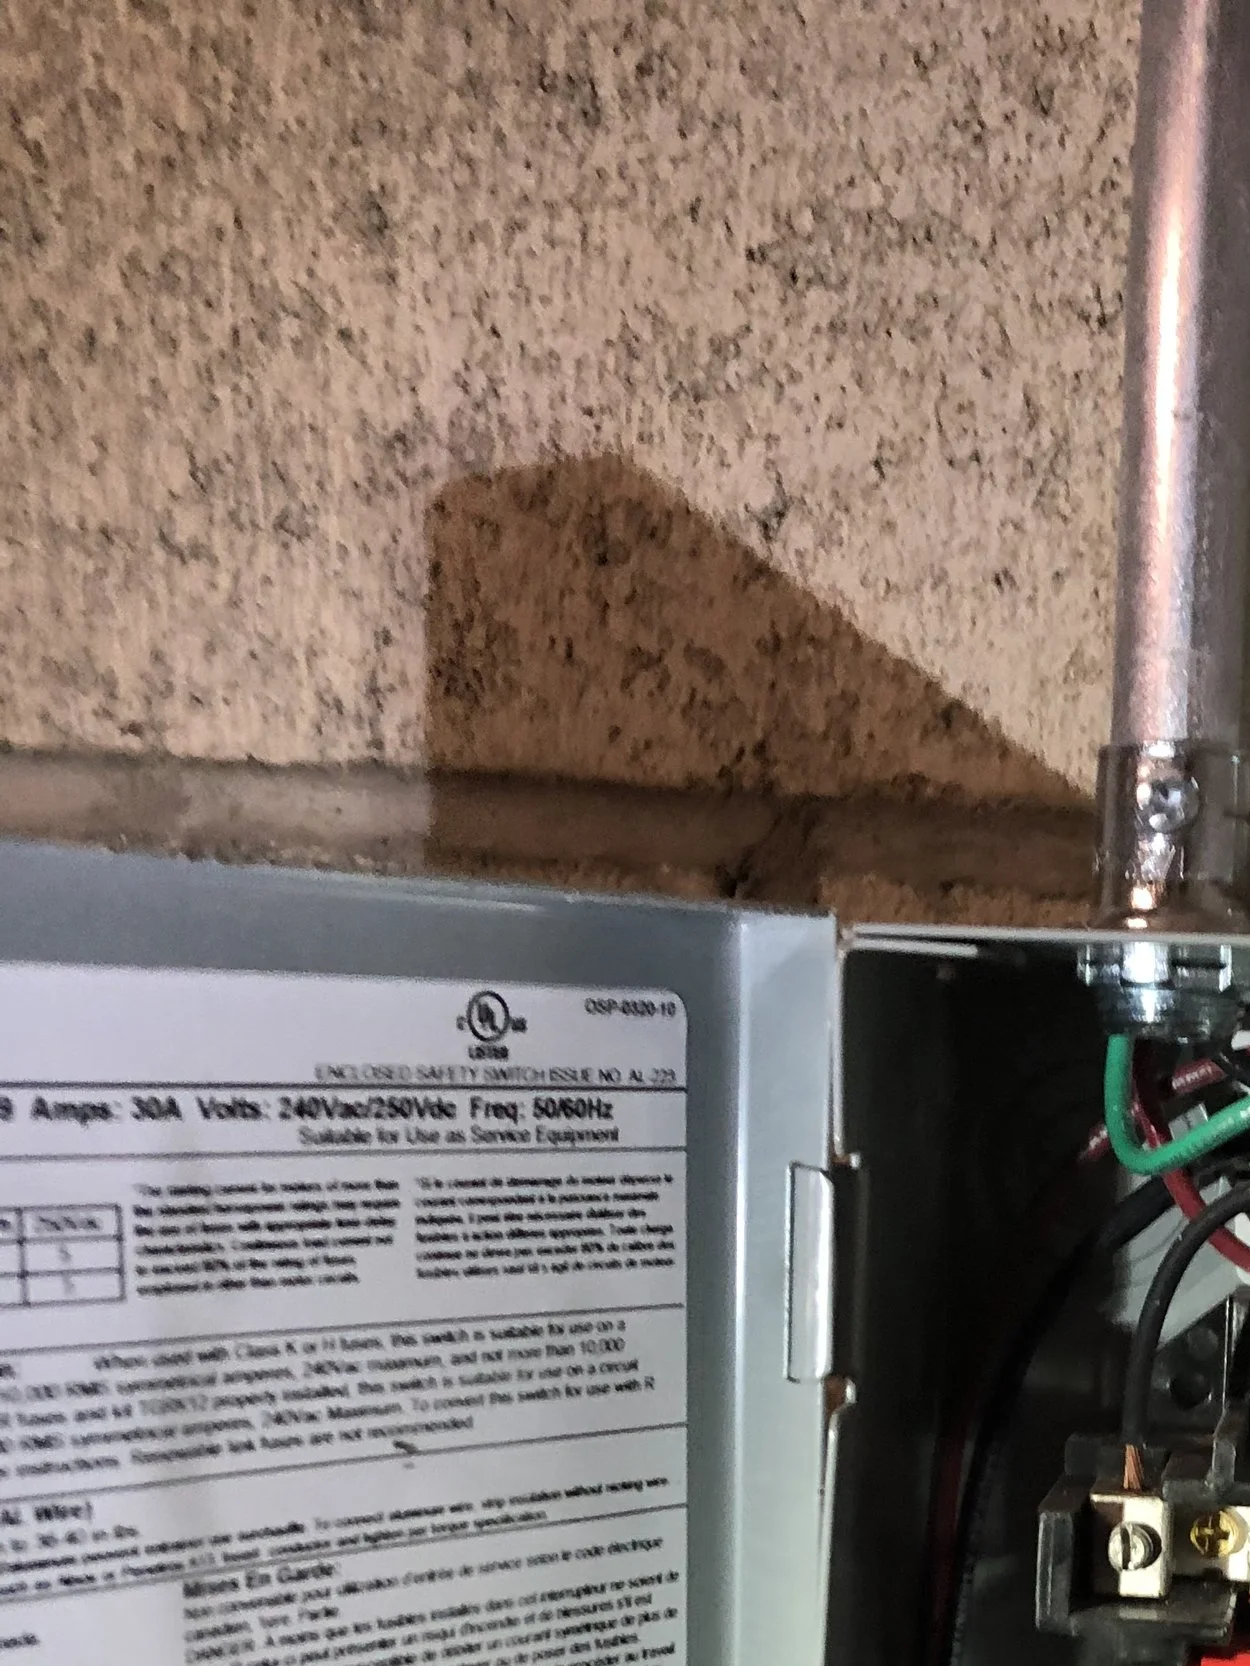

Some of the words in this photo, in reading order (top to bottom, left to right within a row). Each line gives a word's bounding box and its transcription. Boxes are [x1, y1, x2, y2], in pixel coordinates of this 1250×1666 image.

[416, 1064, 477, 1083] SAFETY
[483, 1065, 545, 1083] SWITCH
[549, 1066, 592, 1083] ISSUE
[131, 1096, 182, 1121] 30A
[300, 1126, 372, 1145] Suitable
[376, 1127, 398, 1145] for
[405, 1127, 440, 1145] Use
[445, 1131, 466, 1145] as
[470, 1126, 531, 1145] Service
[536, 1126, 620, 1147] Equipment
